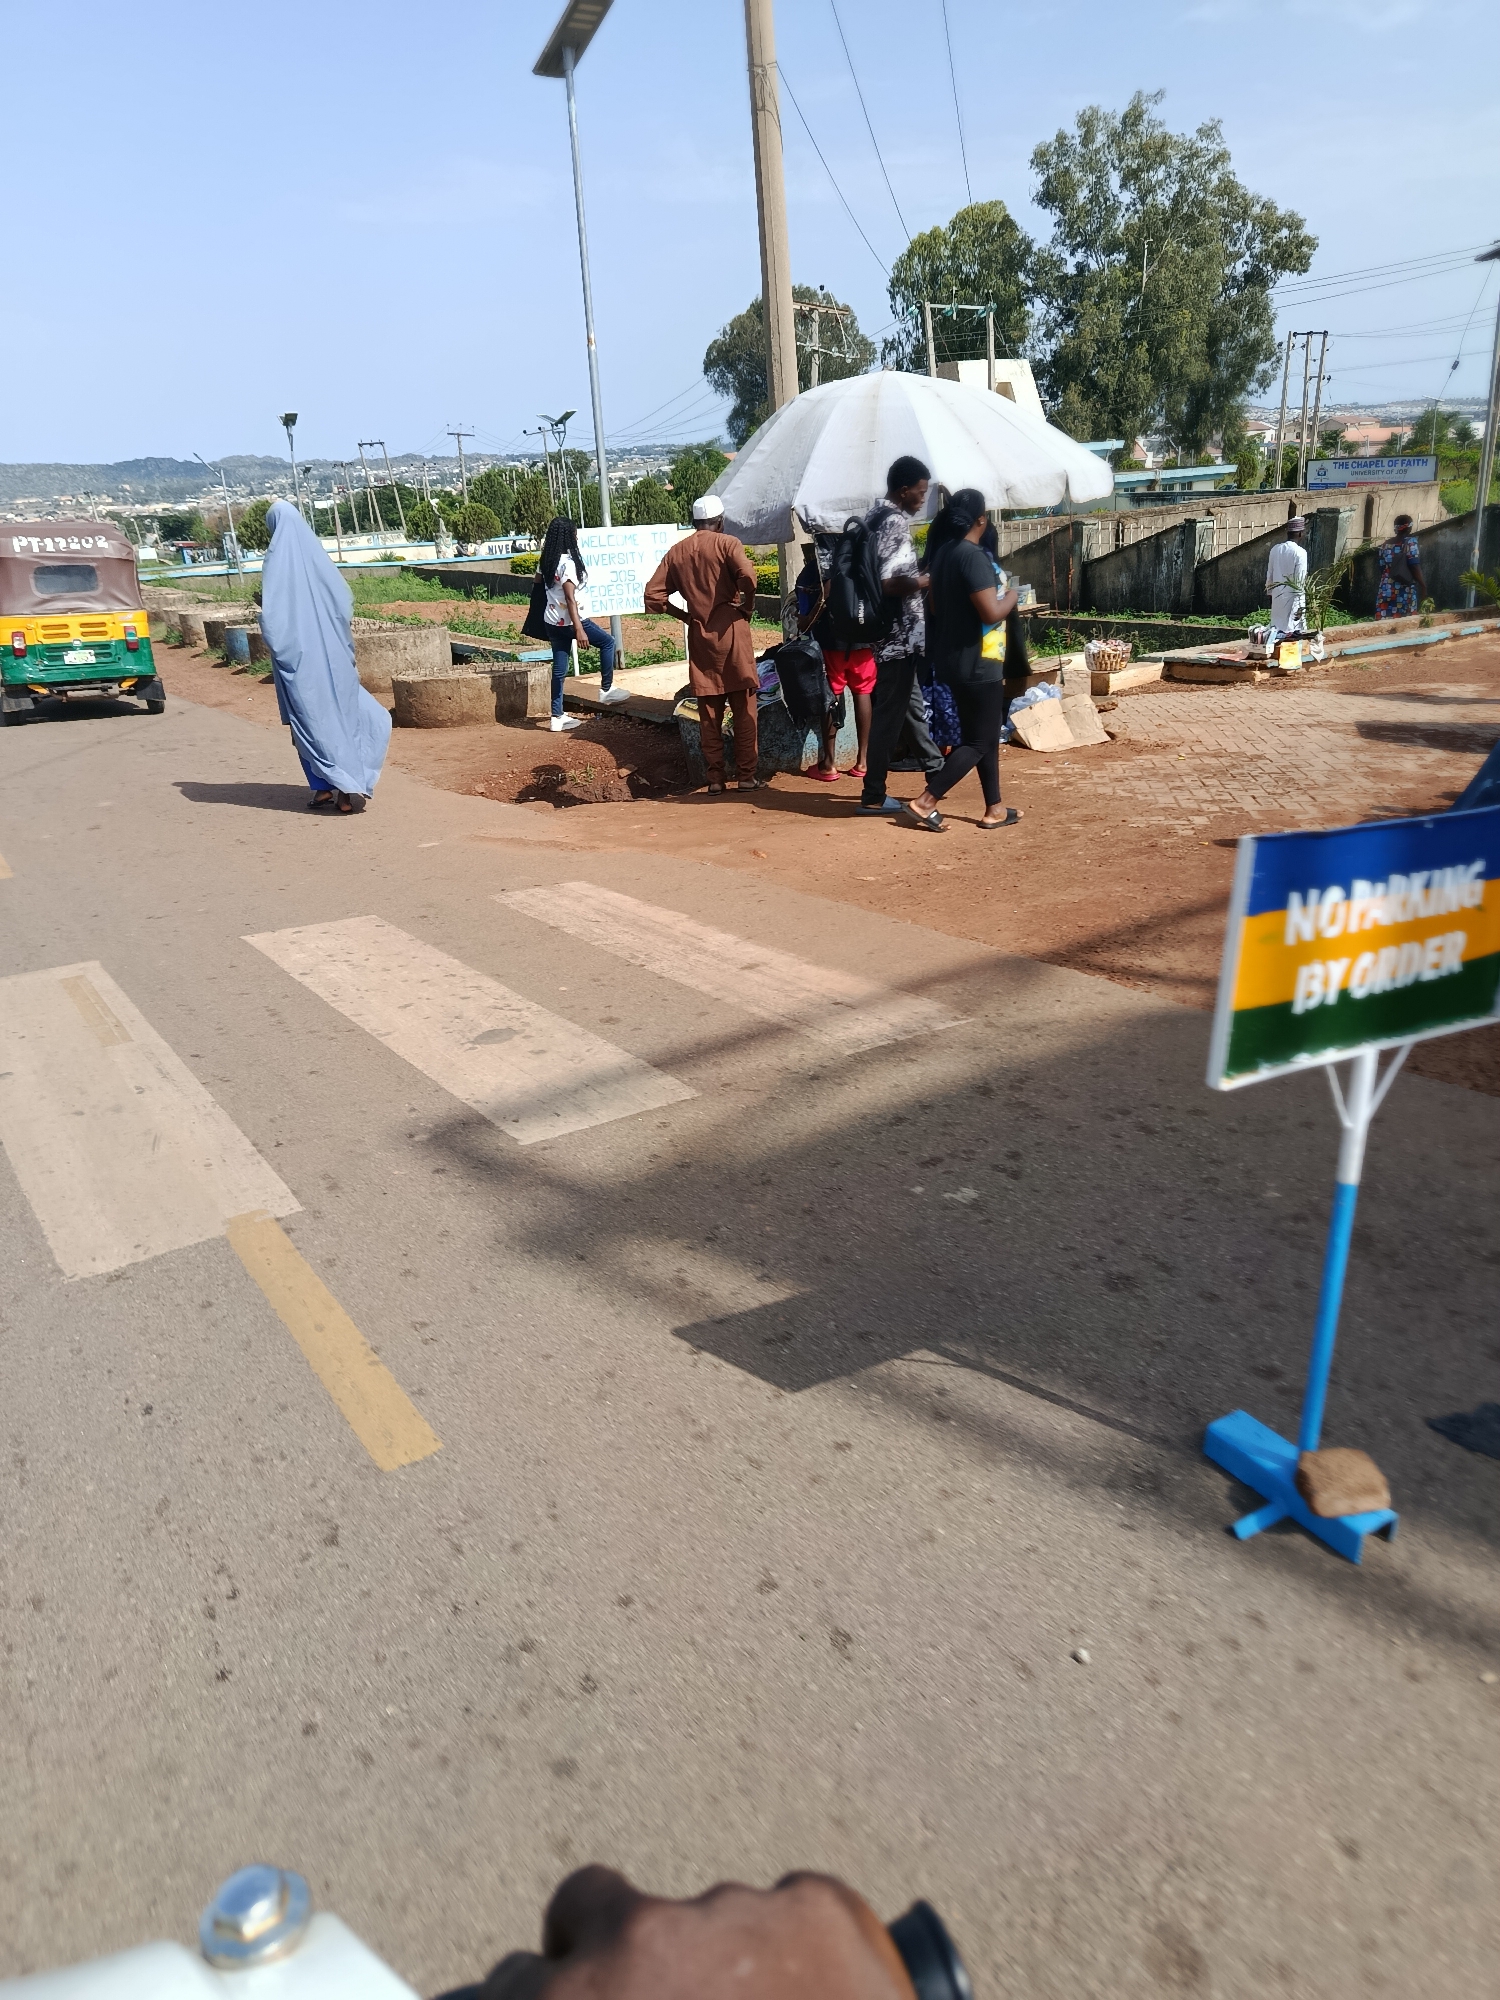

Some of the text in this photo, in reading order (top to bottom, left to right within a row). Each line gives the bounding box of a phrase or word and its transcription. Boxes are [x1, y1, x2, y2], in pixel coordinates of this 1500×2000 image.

[1333, 458, 1428, 470] THE CHAPEL OF FAITH
[581, 532, 667, 548] WELCOME TO
[582, 551, 644, 567] NIVERSITY
[610, 569, 636, 583] JOS
[592, 595, 645, 613] ENTRANC
[1284, 859, 1486, 946] NO PARKING
[1291, 930, 1467, 1015] BY ORDER
